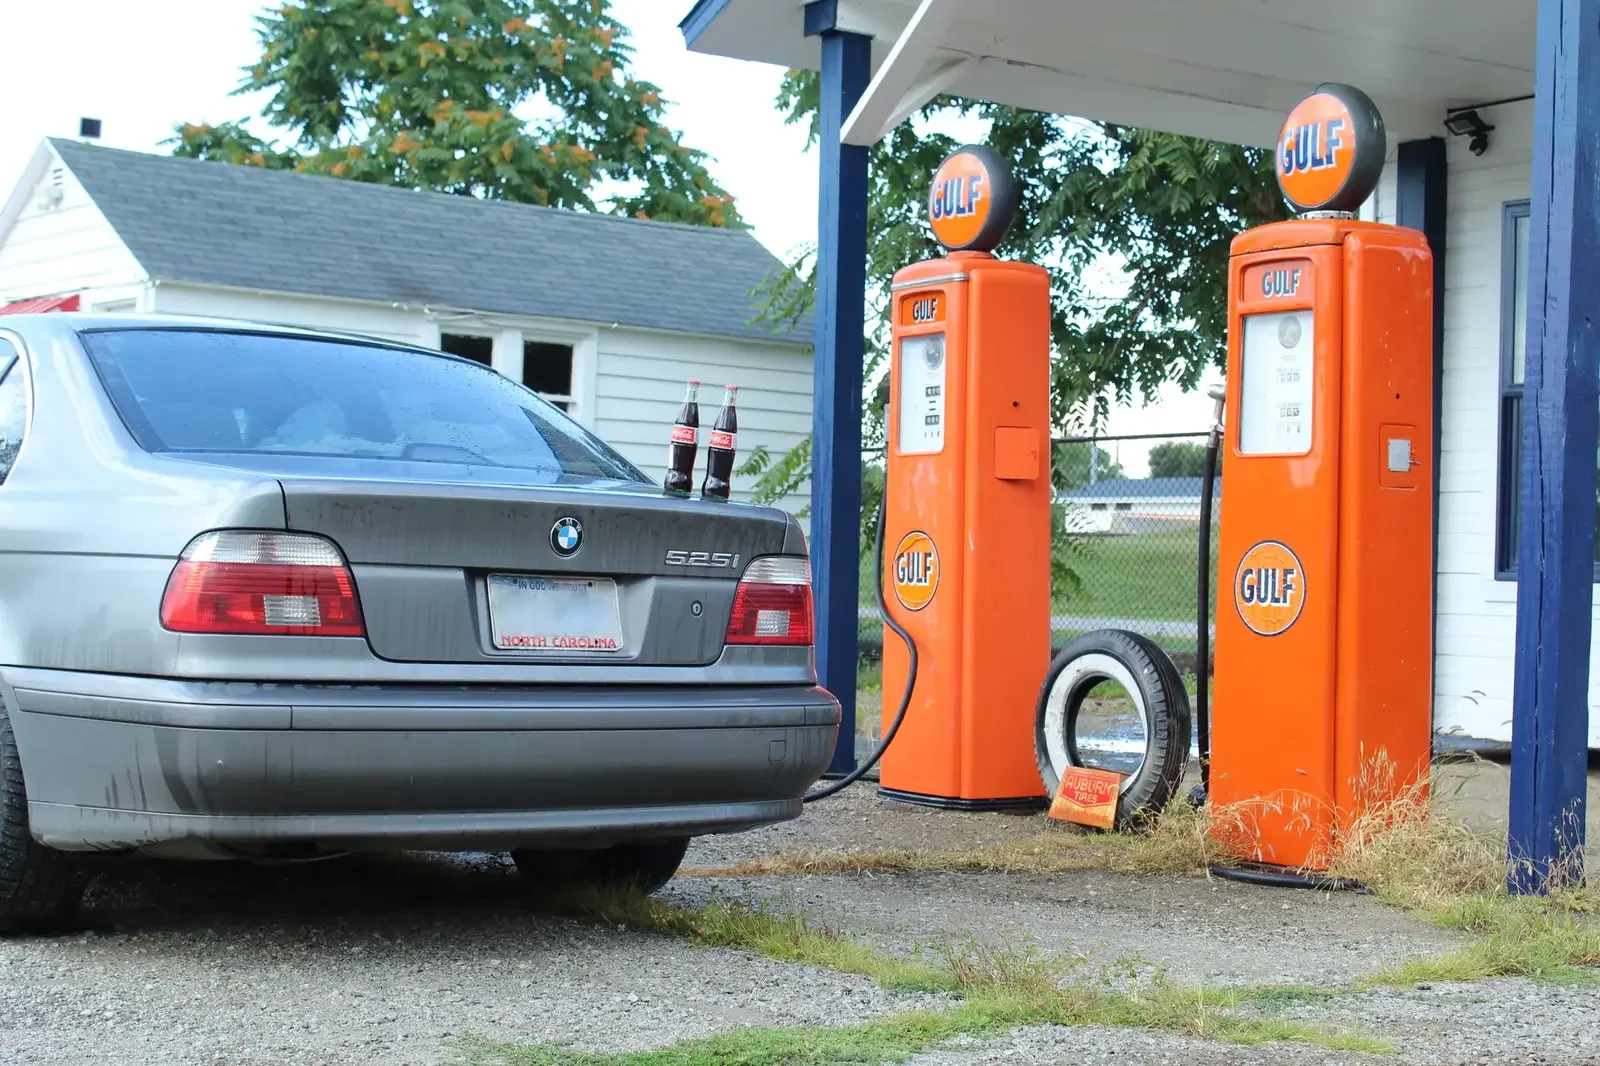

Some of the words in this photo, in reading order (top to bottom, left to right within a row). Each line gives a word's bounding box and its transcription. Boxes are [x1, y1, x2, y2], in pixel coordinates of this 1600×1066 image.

[1280, 119, 1345, 176] GULF
[931, 175, 984, 221] GULF
[1262, 268, 1302, 298] GULF
[912, 298, 938, 323] GULF
[896, 552, 934, 586] GULF
[518, 581, 527, 590] IN
[529, 581, 546, 591] GOD
[1241, 568, 1297, 607] GULF
[501, 635, 547, 647] NORTH
[551, 637, 617, 649] CAROLINA
[1074, 790, 1098, 804] TIRES
